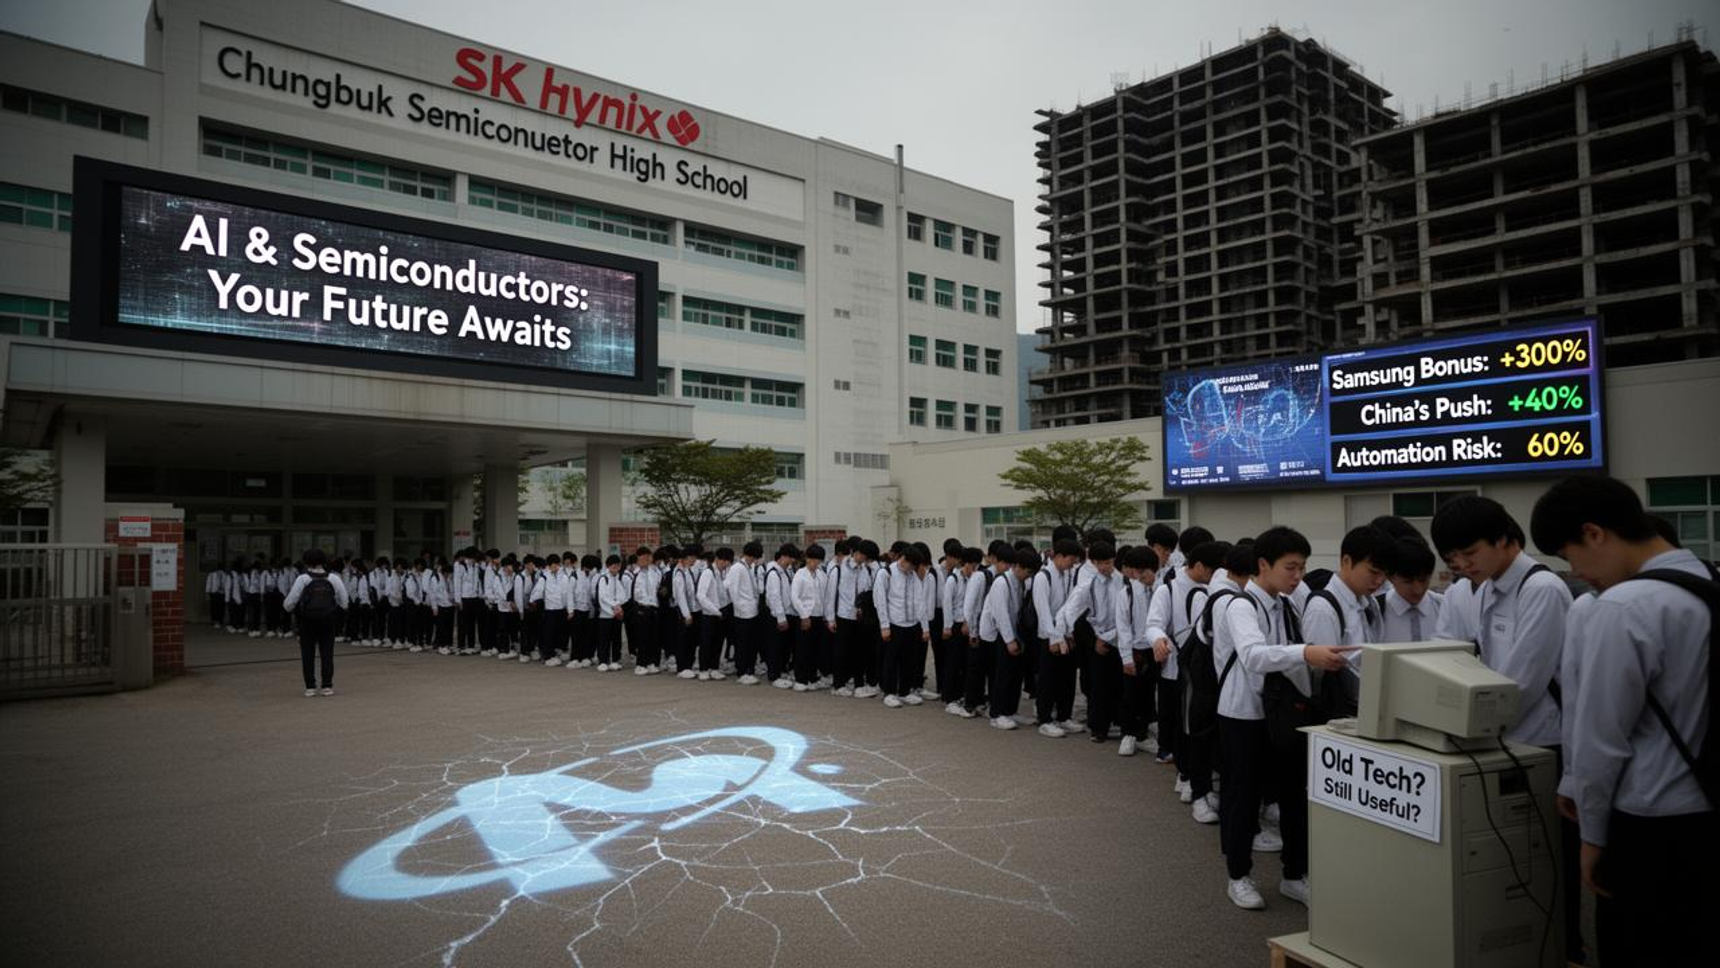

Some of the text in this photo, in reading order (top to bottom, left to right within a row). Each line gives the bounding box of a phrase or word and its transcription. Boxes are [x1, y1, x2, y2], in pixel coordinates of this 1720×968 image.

[452, 47, 662, 139] SK hynix
[216, 45, 395, 118] Chungbuk
[610, 141, 666, 183] High
[675, 159, 748, 200] School
[180, 214, 589, 311] AI & Semiconductors:
[207, 268, 572, 350] Your Future Awaits
[1331, 338, 1587, 390] Samsung Bonus: +300%
[1360, 385, 1583, 426] China’s Push: +40%
[1336, 431, 1584, 468] Automation Risk: 60%
[1321, 746, 1426, 796] Old Tech?
[1324, 777, 1421, 823] Still Useful?
